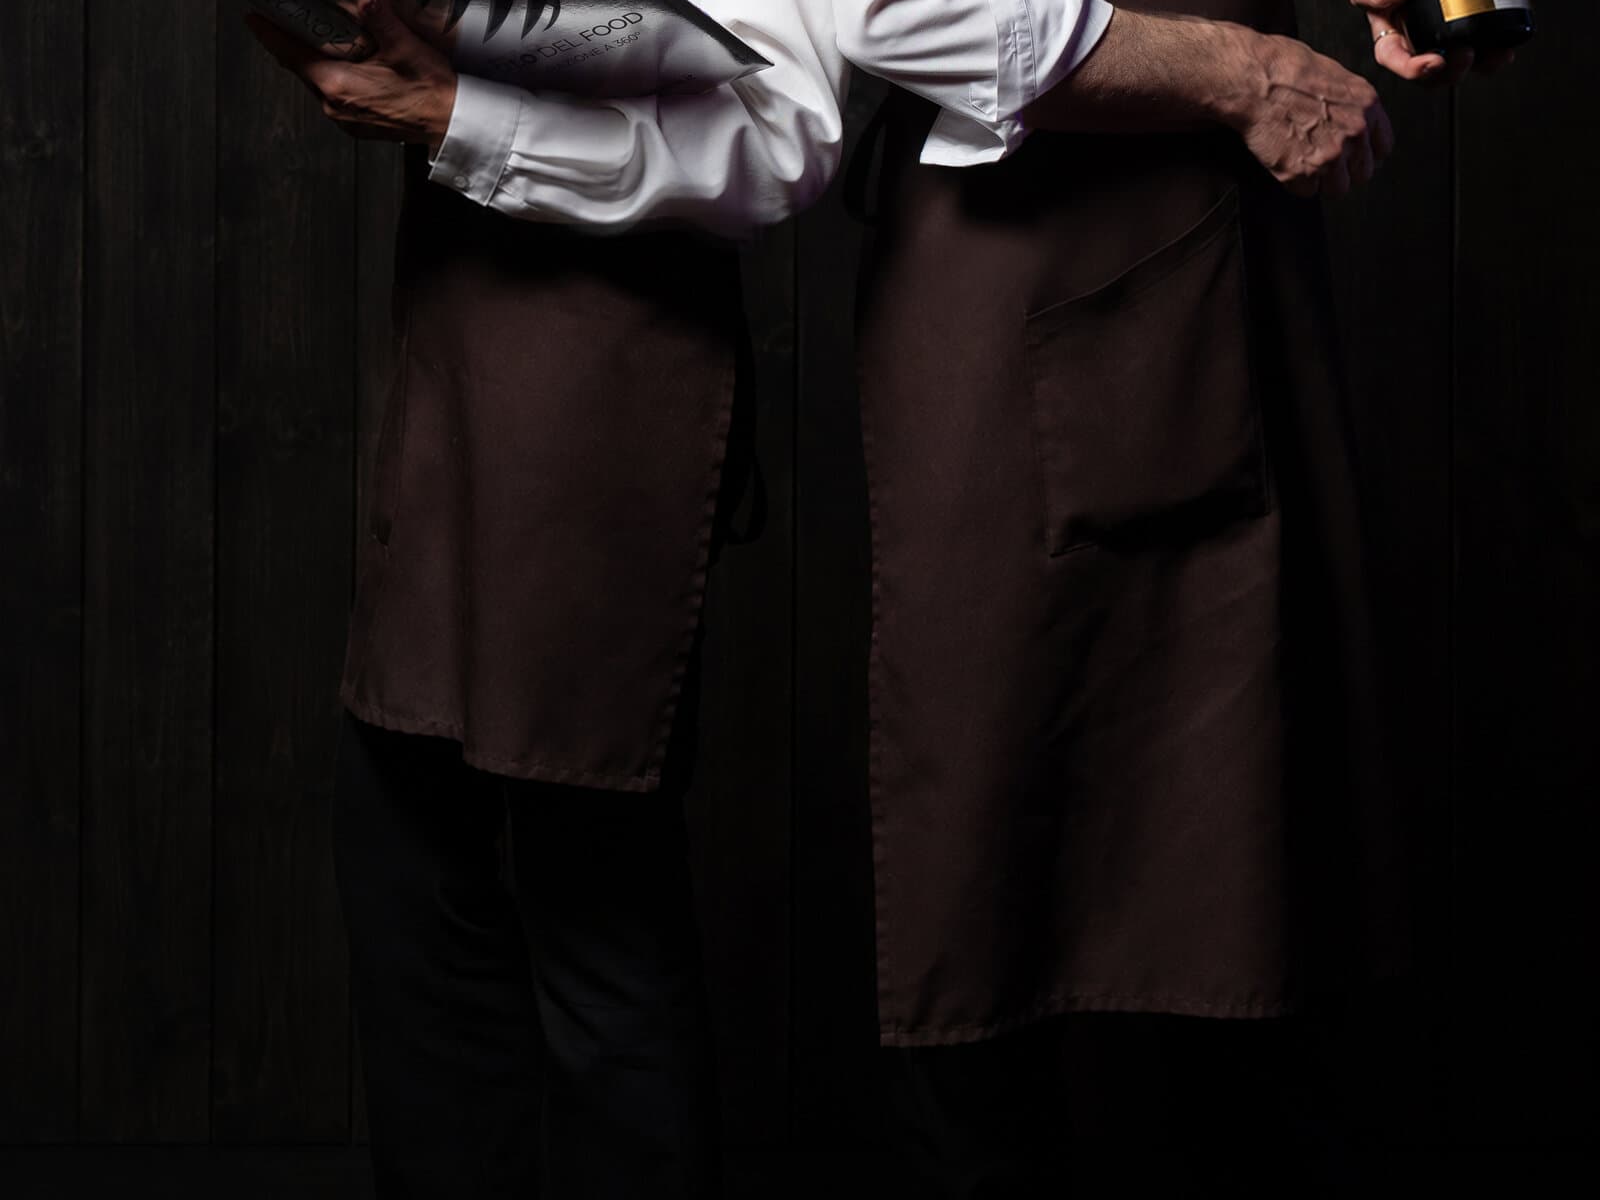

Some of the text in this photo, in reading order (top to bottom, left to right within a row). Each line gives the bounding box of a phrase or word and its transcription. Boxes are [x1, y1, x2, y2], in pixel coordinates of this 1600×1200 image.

[536, 38, 585, 59] DEL
[579, 11, 644, 42] FOOD
[605, 43, 616, 53] A
